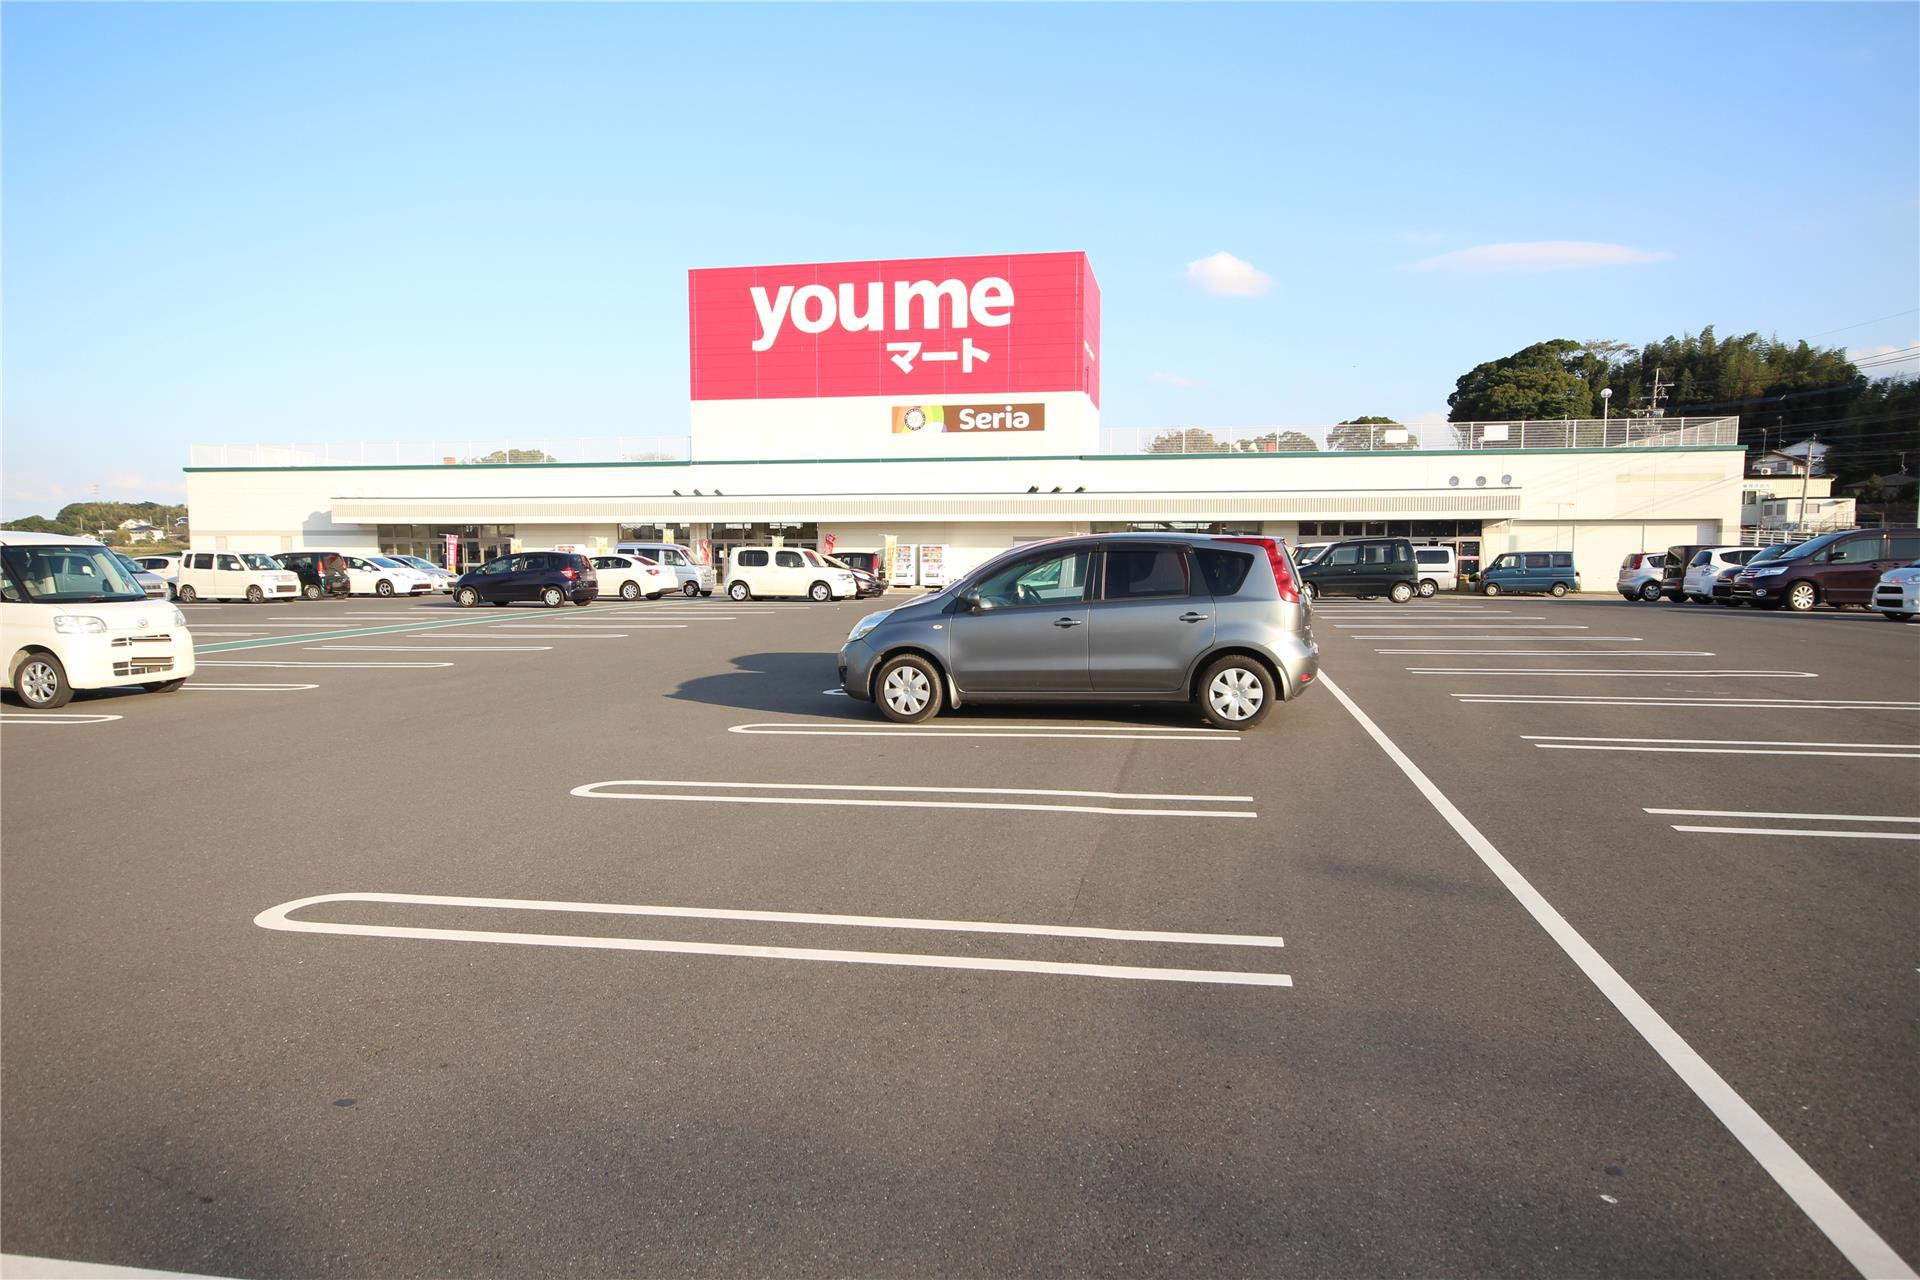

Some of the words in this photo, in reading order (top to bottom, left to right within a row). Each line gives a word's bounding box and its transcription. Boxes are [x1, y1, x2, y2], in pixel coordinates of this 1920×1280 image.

[886, 337, 991, 374] マート
[959, 405, 1030, 430] Seria
